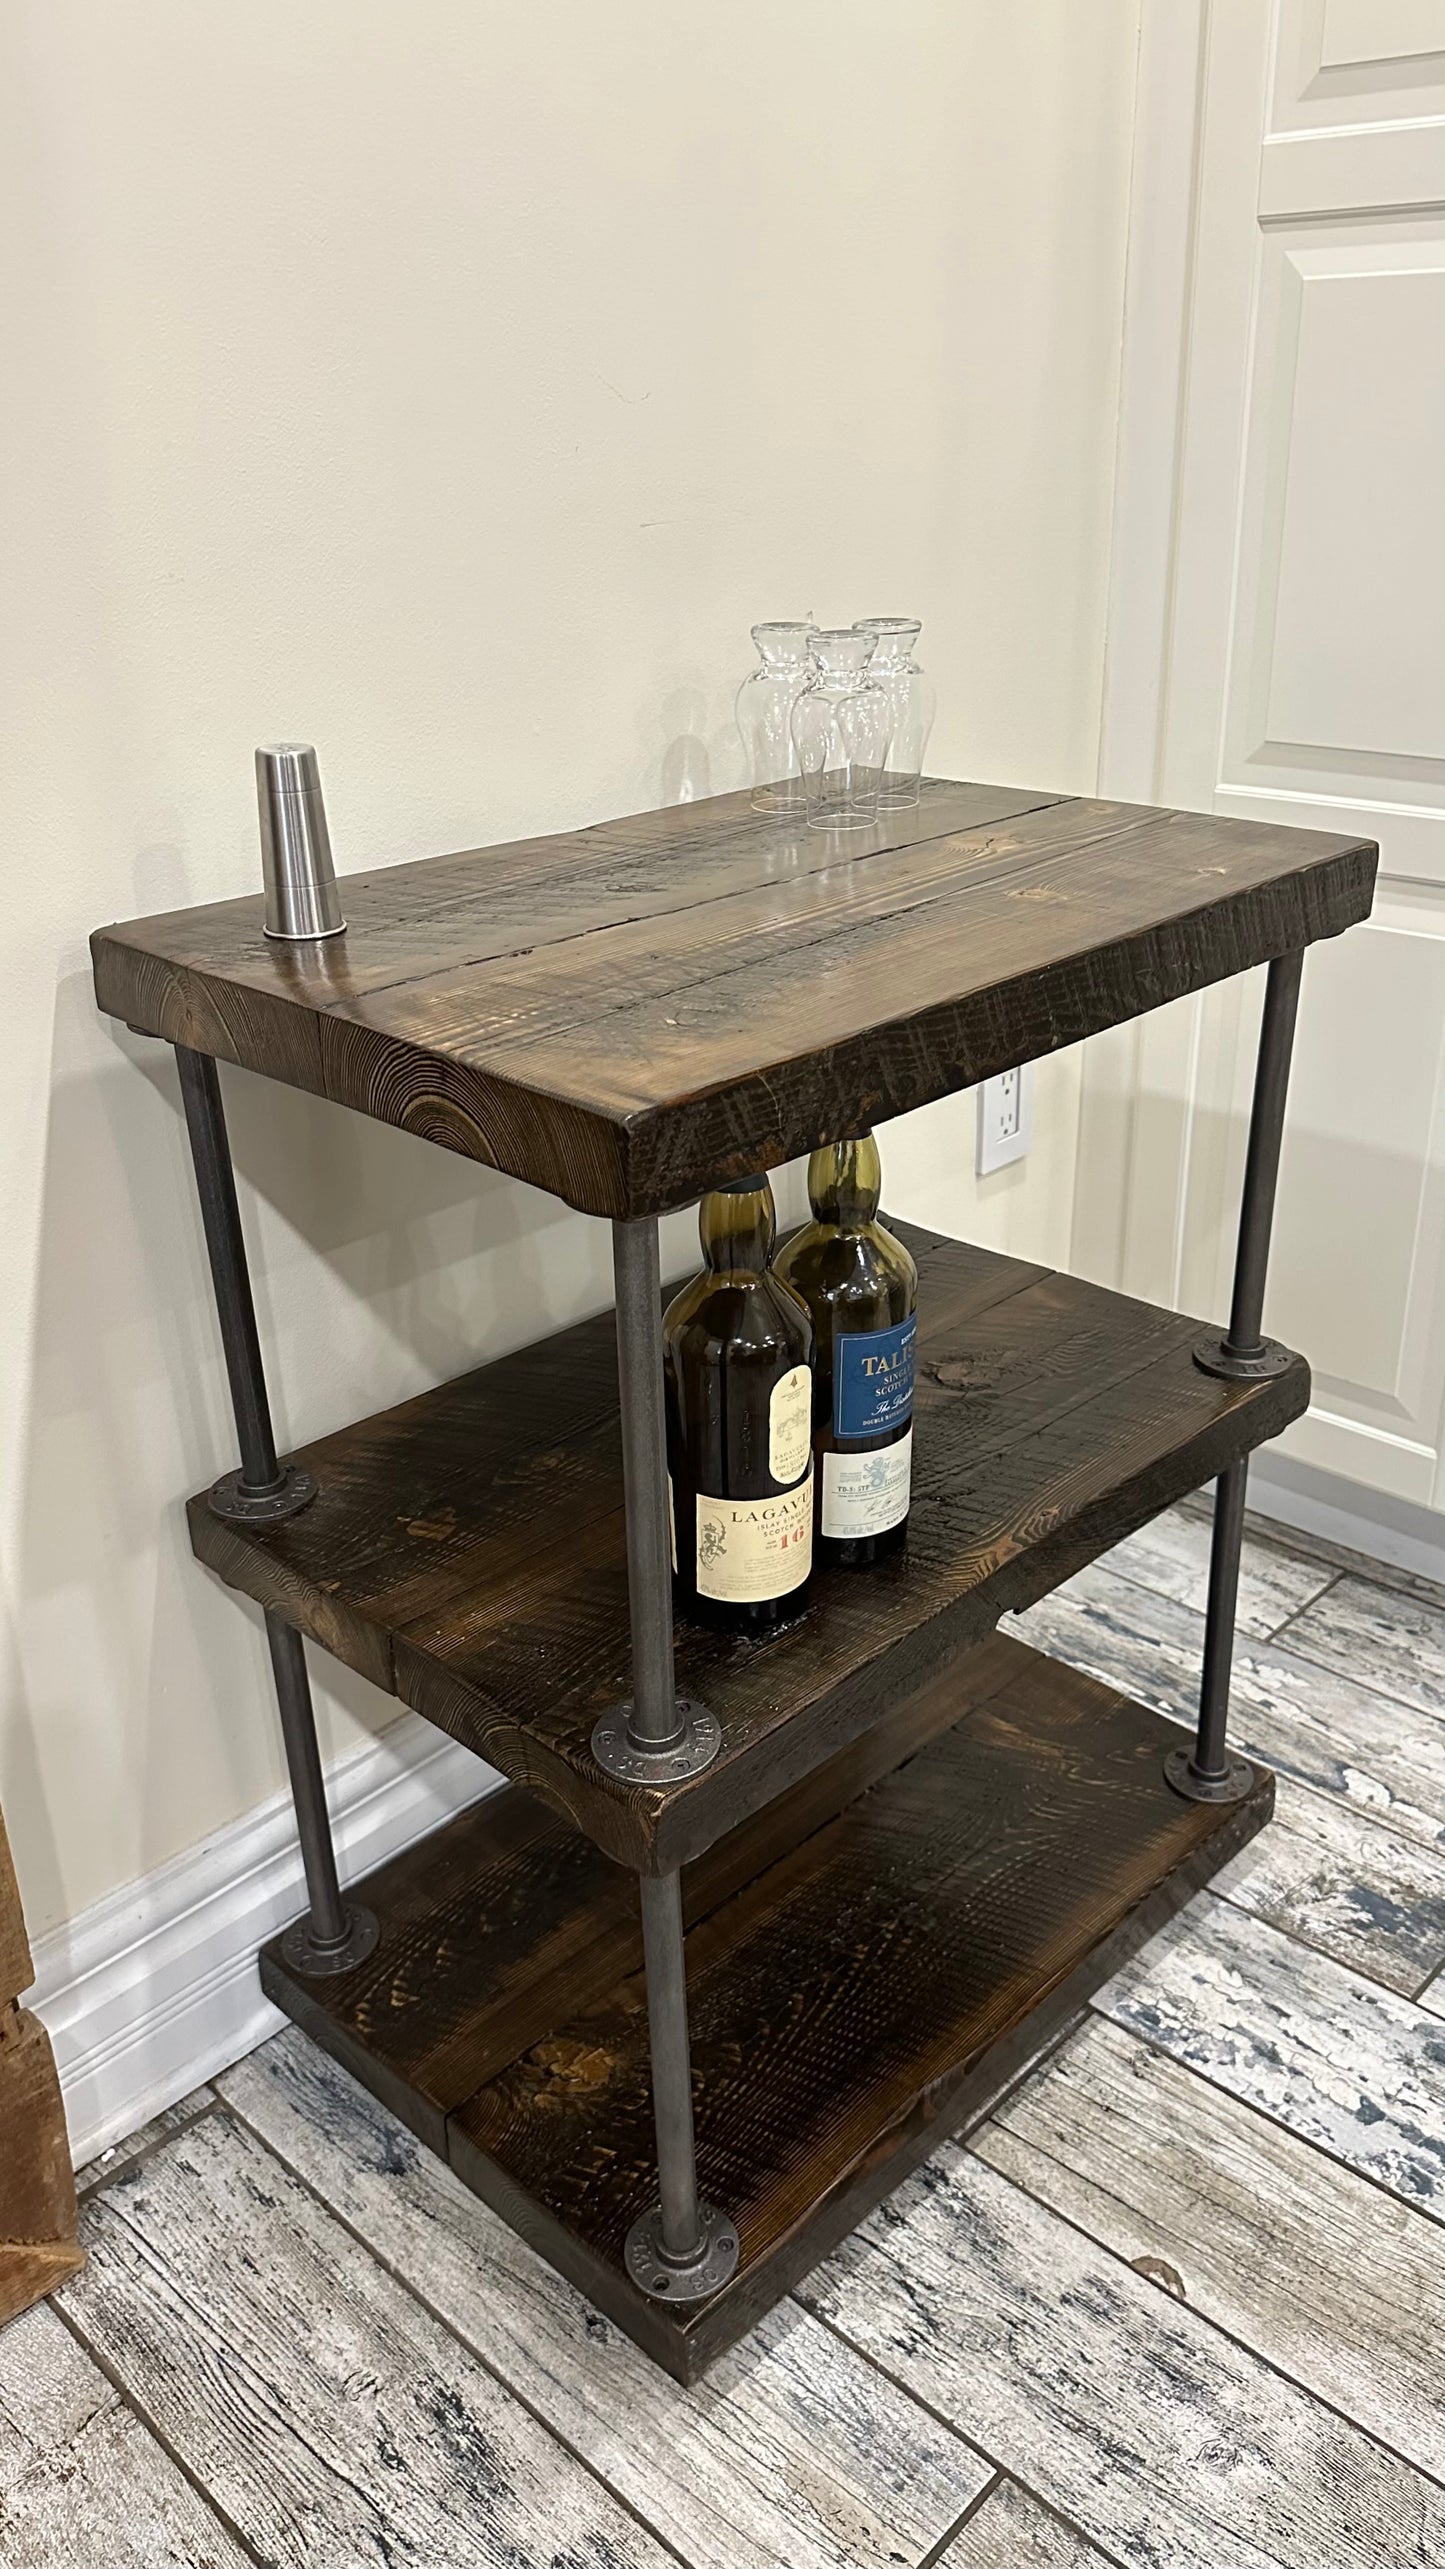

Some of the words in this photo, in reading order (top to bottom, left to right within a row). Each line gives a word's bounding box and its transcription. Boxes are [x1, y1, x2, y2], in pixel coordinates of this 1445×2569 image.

[757, 1521, 780, 1531] ISLAY
[763, 1524, 794, 1538] SCOTCH
[780, 1525, 805, 1549] 16
